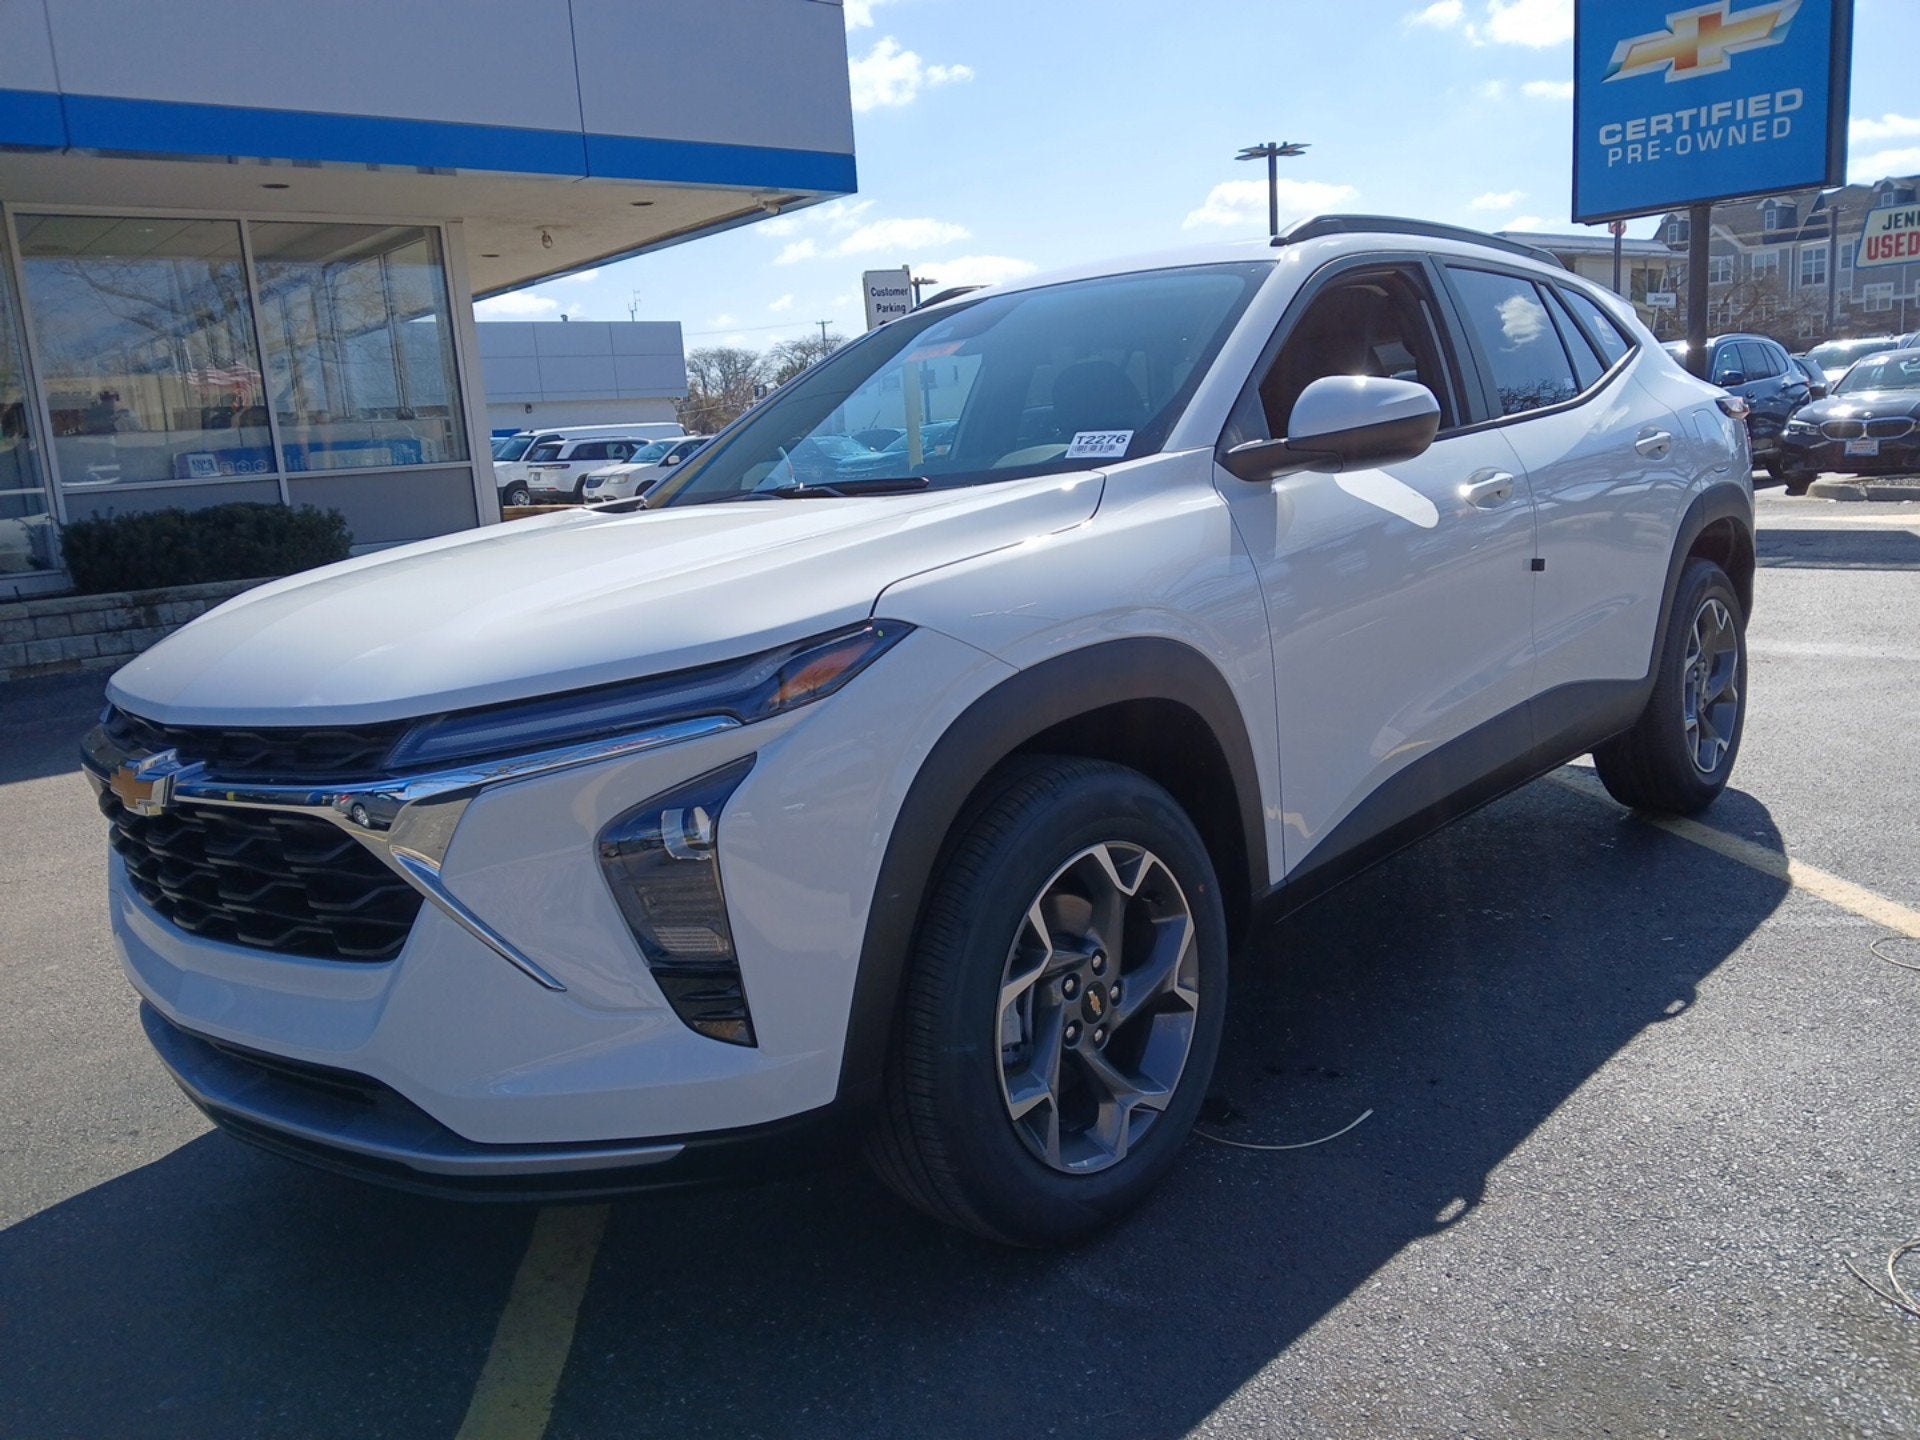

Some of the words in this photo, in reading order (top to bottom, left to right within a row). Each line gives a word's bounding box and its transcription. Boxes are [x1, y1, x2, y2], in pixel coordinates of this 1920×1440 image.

[1599, 88, 1804, 146] CERTIFIED
[1607, 116, 1792, 168] PRE-OWNED
[1882, 210, 1920, 231] JEN
[1867, 231, 1920, 261] USED
[870, 287, 909, 297] Customer
[876, 302, 906, 314] Parking
[1076, 434, 1128, 445] T2276
